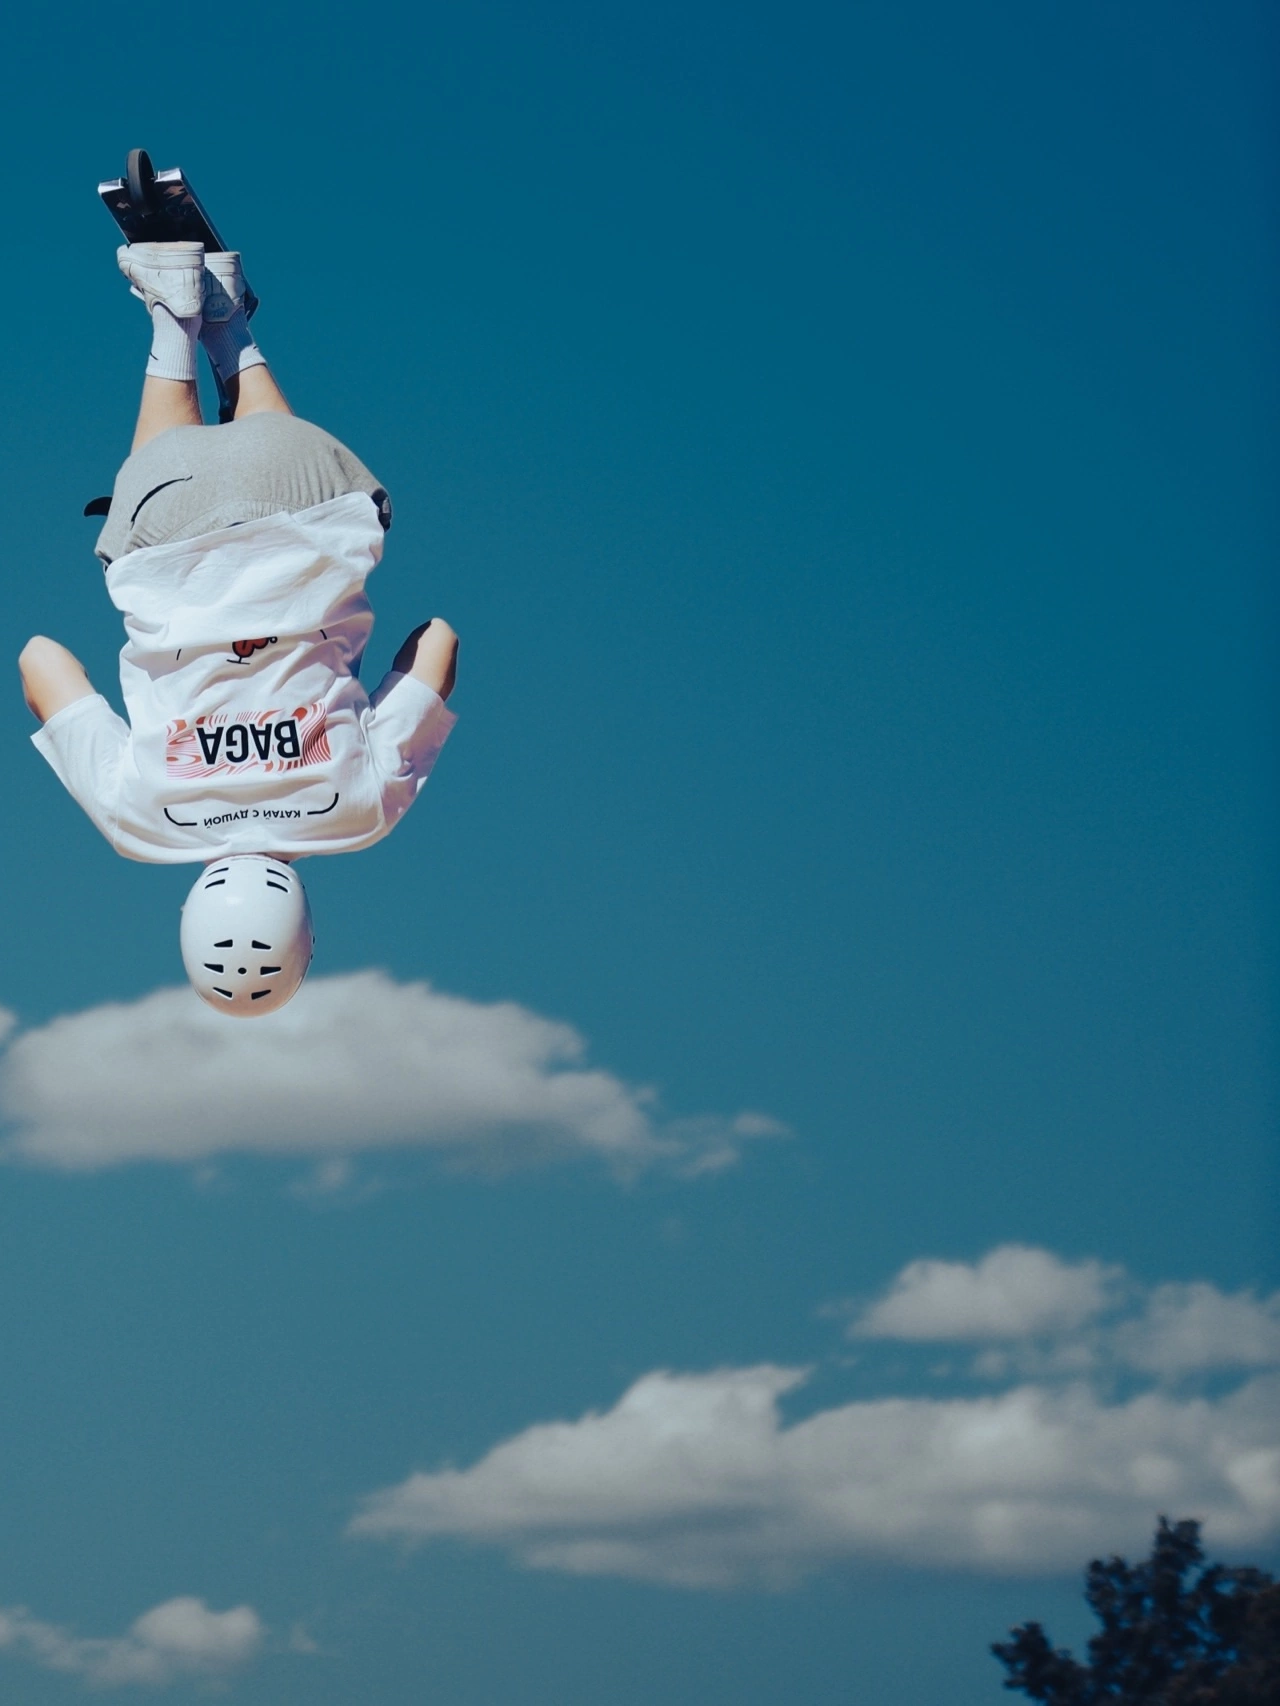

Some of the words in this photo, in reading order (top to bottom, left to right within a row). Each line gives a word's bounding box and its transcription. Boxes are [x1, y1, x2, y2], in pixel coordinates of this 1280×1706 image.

[196, 719, 301, 765] BAGA
[203, 809, 250, 829] ДУШОЙ
[252, 809, 260, 818] С
[263, 809, 301, 819] КАТАЙ
